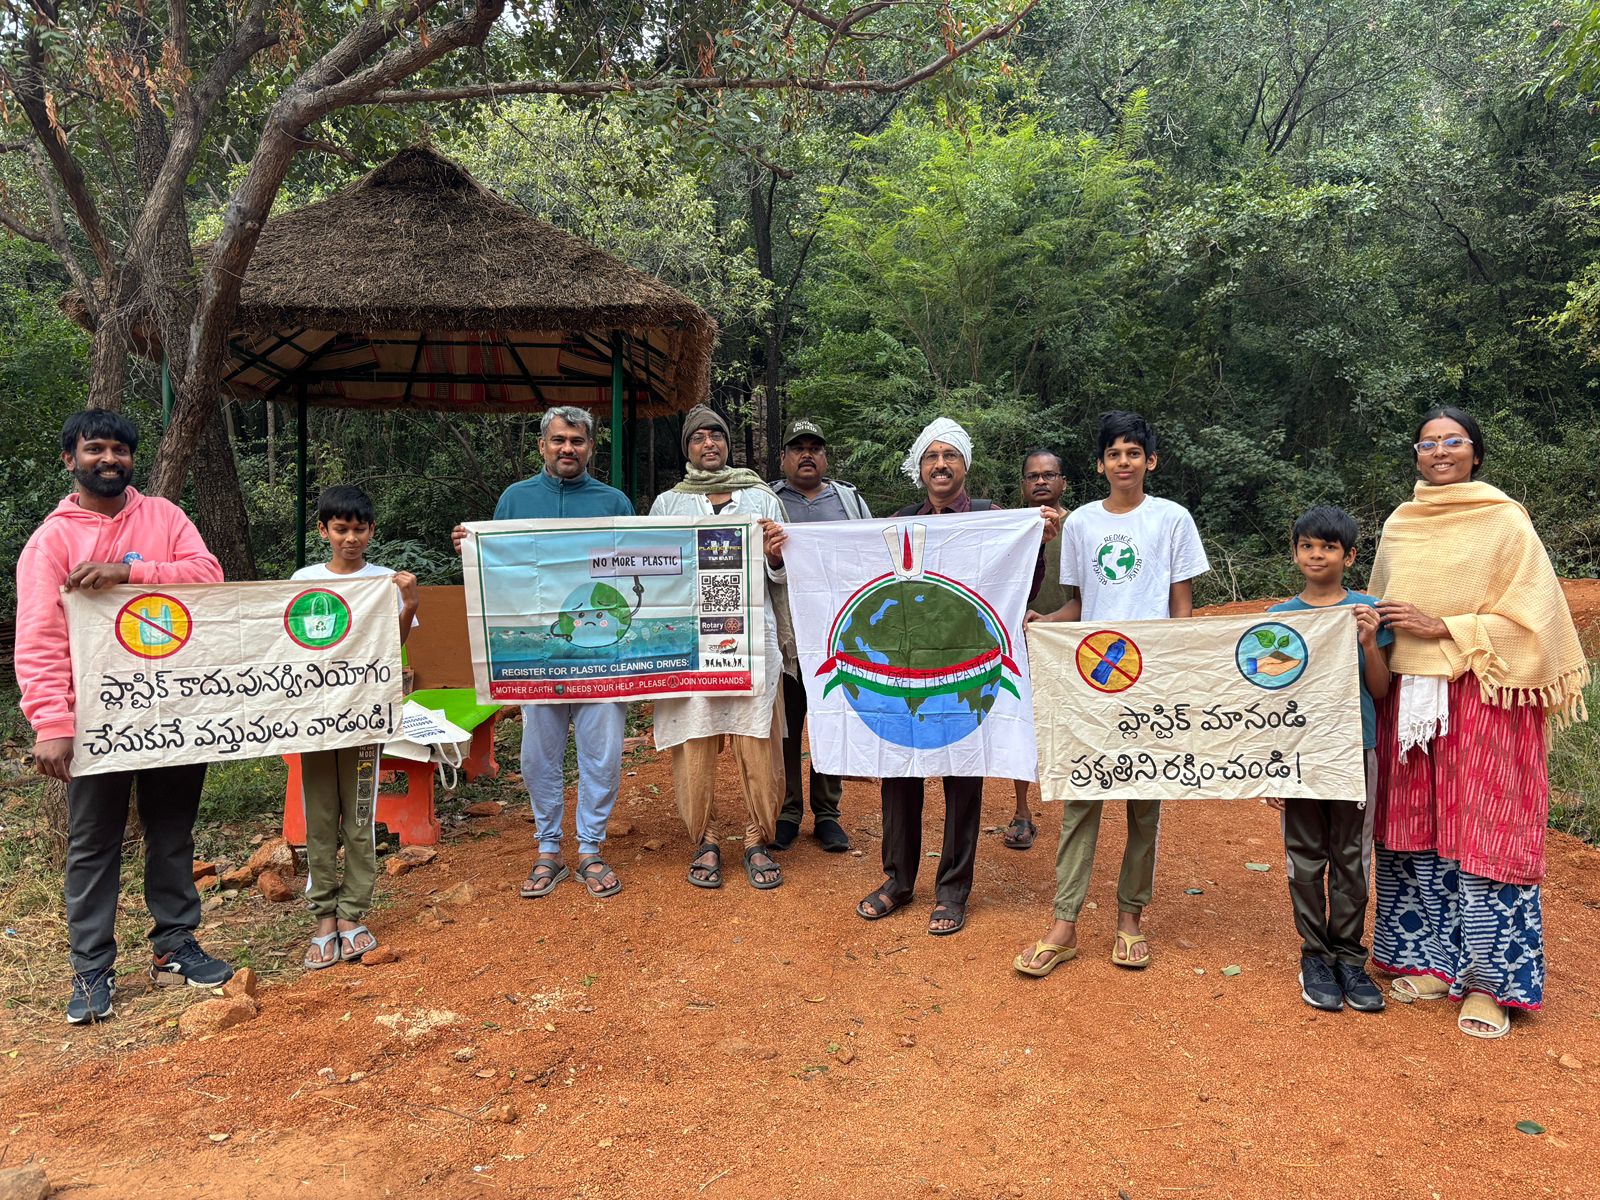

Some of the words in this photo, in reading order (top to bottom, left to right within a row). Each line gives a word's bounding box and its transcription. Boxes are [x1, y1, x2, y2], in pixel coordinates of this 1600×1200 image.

[592, 557, 608, 569] NO
[611, 555, 637, 567] MORE
[642, 555, 679, 567] PLASTIC
[701, 622, 724, 630] Rotary
[501, 666, 546, 677] REGISTER
[548, 666, 567, 675] FOR
[570, 664, 607, 675] PLASTIC
[610, 661, 654, 673] CLEANING
[656, 658, 690, 670] DRIVES:
[840, 659, 884, 683] PLASTIC
[885, 672, 915, 689] FREE
[99, 669, 173, 711] ప్లాస్టిక్
[496, 686, 527, 694] MOTHER
[528, 685, 553, 693] EARTH
[566, 684, 592, 693] NEEDS
[592, 683, 614, 692] YOUR
[680, 677, 697, 686] JOIN
[697, 677, 718, 685] YOUR
[1117, 703, 1192, 740] ప్లాస్టిక్
[1200, 700, 1307, 732] మానండి
[82, 717, 186, 756] చేసుకునే
[194, 715, 299, 755] వస్తువులు
[1070, 752, 1157, 790] ప్రకృతిని
